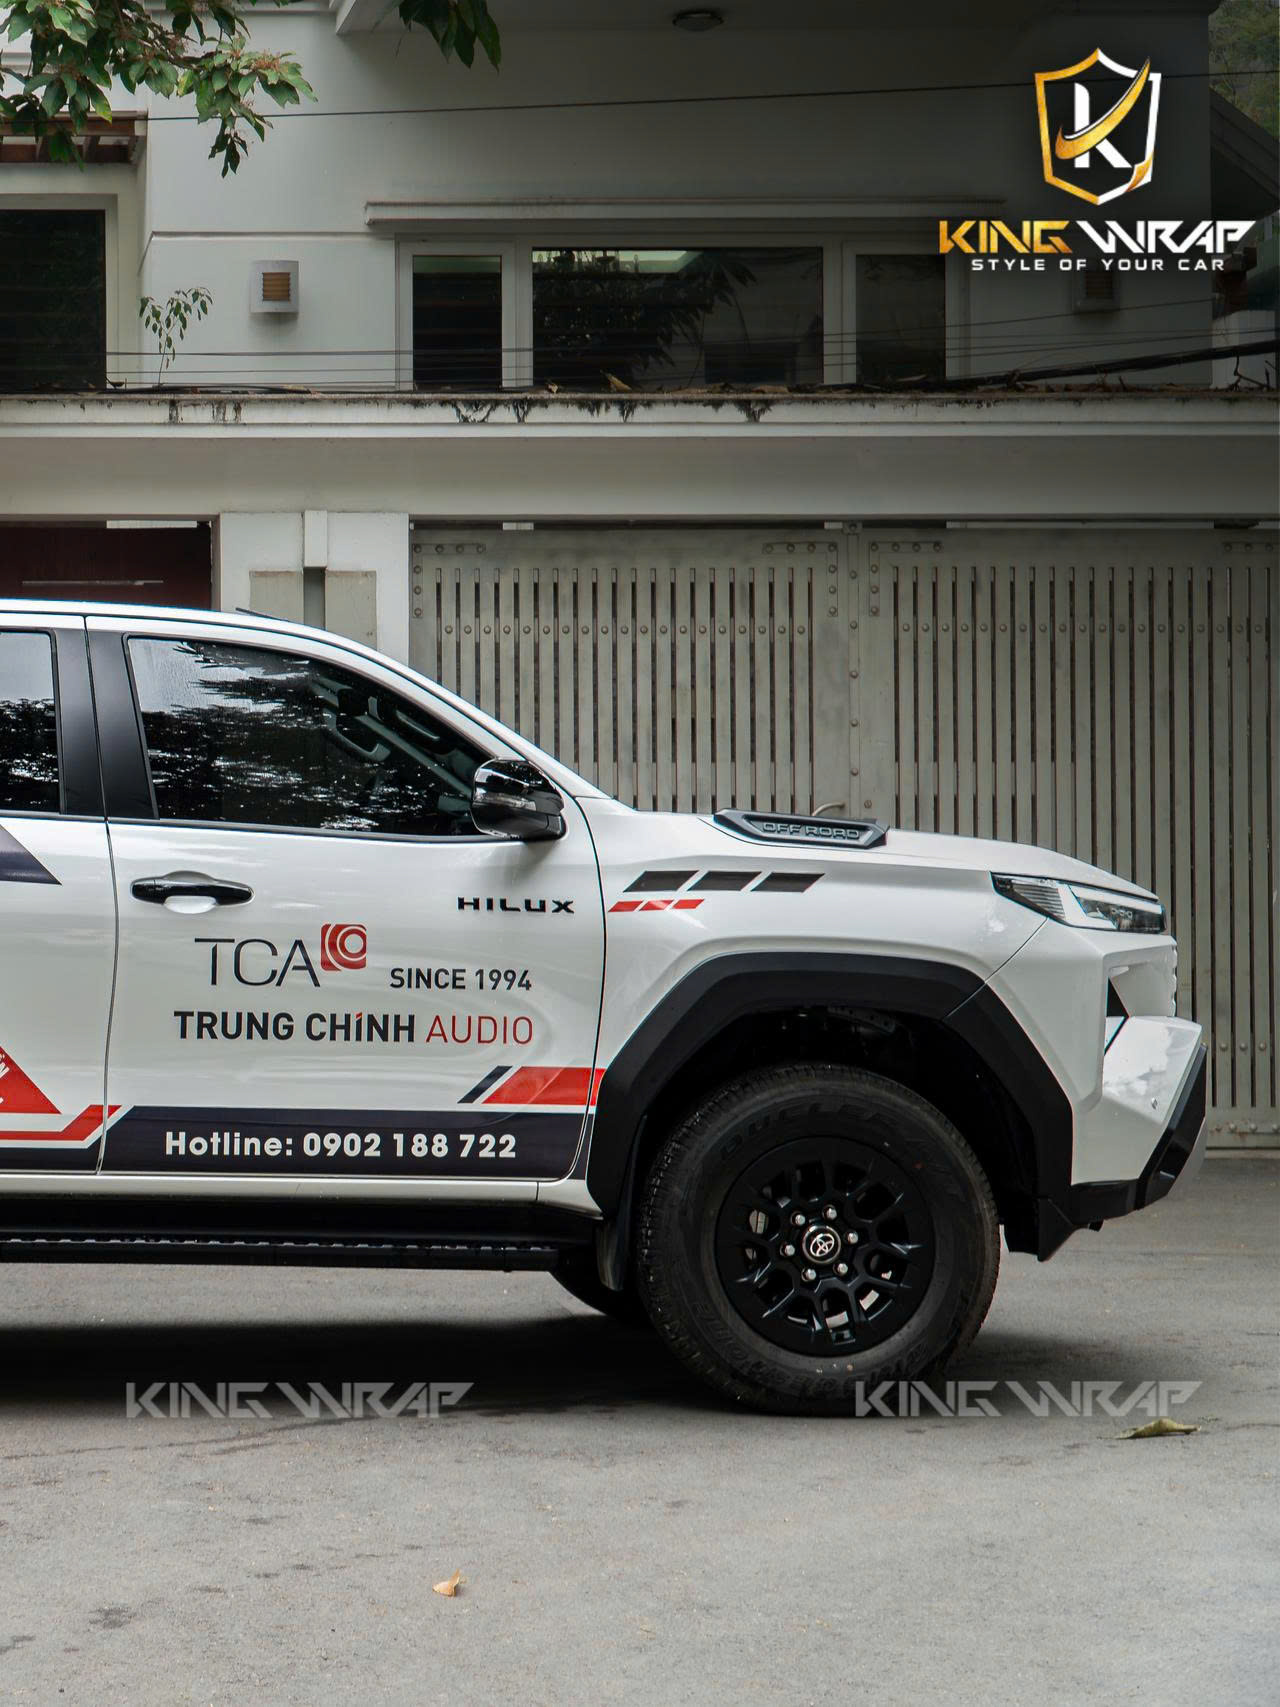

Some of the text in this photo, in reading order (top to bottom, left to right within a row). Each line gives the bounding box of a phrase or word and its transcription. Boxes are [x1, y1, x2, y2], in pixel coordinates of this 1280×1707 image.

[457, 897, 575, 914] HILUX
[194, 938, 320, 988] TCA
[389, 968, 532, 991] SINCE 1994
[173, 1010, 533, 1044] TRUNG CHÍNH AUDIO
[165, 1131, 516, 1158] Hotline: 0902 188 722
